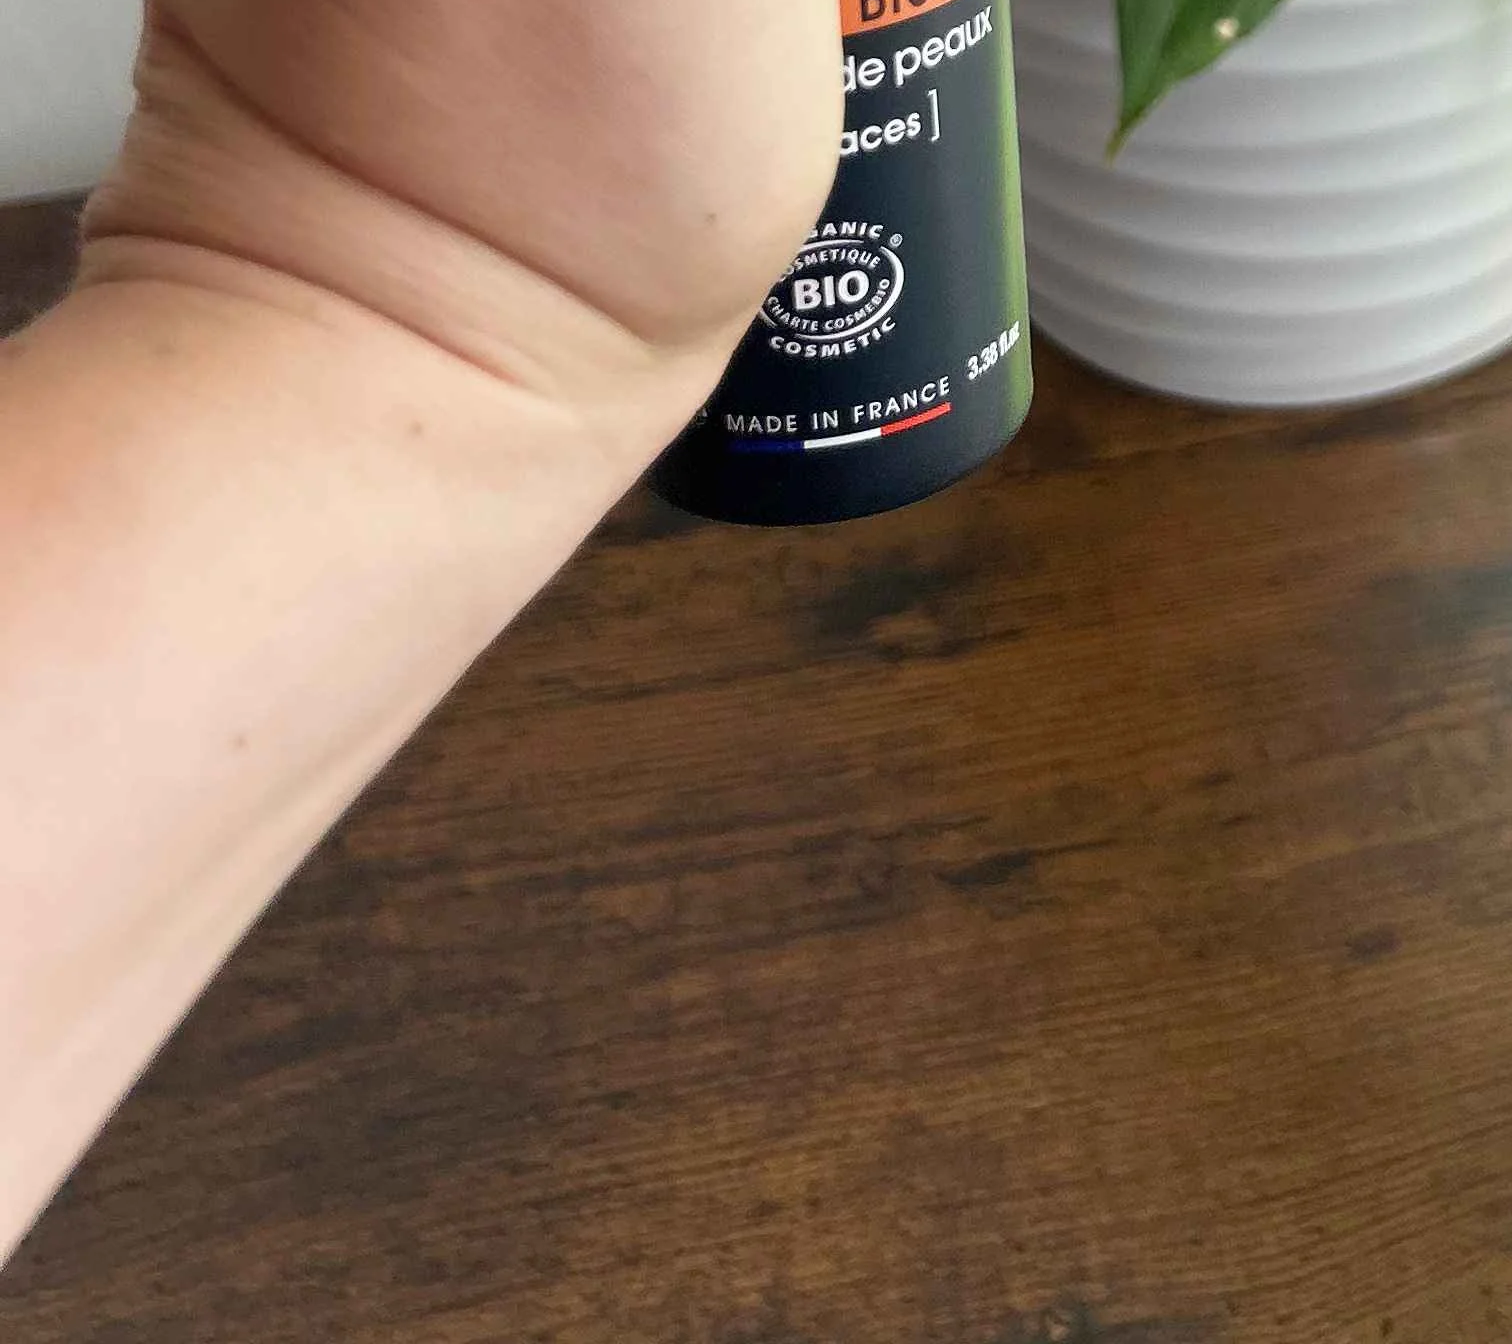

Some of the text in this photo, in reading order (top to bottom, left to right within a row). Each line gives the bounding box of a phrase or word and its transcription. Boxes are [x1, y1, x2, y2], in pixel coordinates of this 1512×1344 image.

[843, 6, 994, 92] de peaux
[781, 249, 881, 282] SMETIQUE
[767, 278, 891, 332] CHARTE COSMEBIO
[793, 269, 870, 310] BIO
[769, 317, 896, 358] COSMETIC
[726, 414, 798, 433] MADE
[812, 409, 839, 430] IN
[853, 376, 951, 425] FRANCE
